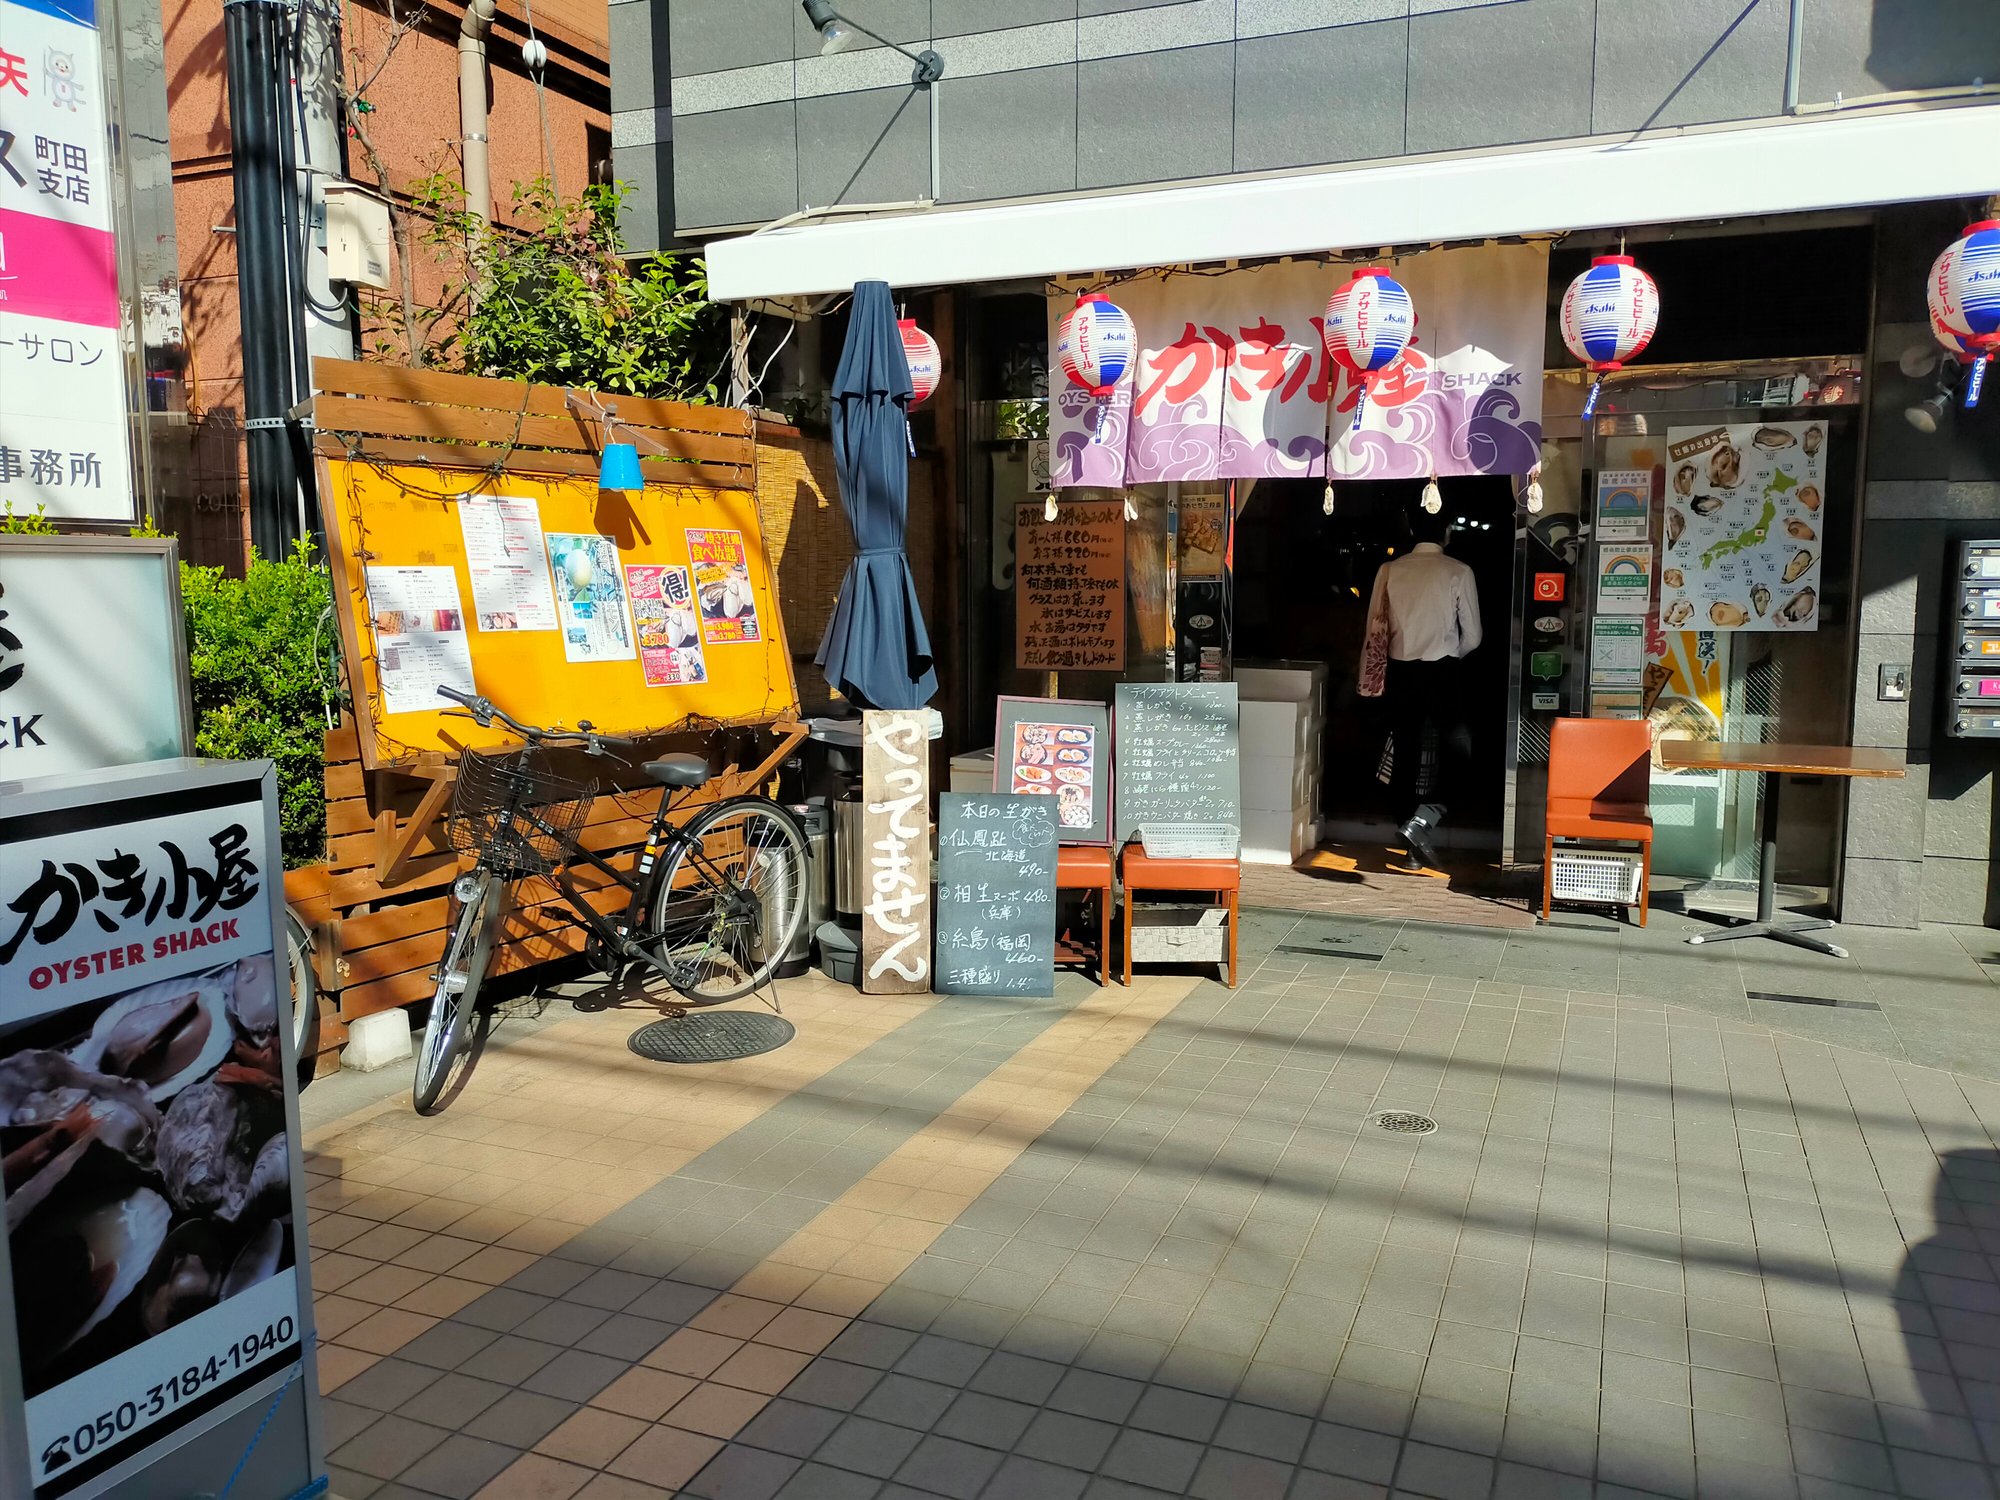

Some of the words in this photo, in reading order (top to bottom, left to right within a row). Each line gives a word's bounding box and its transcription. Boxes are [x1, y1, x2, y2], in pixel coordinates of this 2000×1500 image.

[35, 135, 89, 175] 町田
[37, 168, 91, 206] 支店
[1938, 251, 1956, 317] アサヒビール
[1357, 291, 1371, 349] アサヒビール
[1383, 313, 1407, 325] Asahi
[1565, 282, 1579, 343] アサヒビール
[1584, 302, 1616, 315] Asahi
[1626, 277, 1644, 339] アサヒビール
[1078, 315, 1094, 371] アサヒビール
[1103, 332, 1127, 342] Asahi
[1444, 373, 1522, 388] SHACK
[1968, 356, 1987, 403] アサヒビール
[661, 569, 689, 604] 得!
[1028, 620, 1042, 633] 水
[865, 713, 928, 983] やってません
[949, 828, 1007, 848] 仙鳳趾
[985, 849, 1030, 862] 北海道
[0, 824, 259, 966] かき小屋
[28, 942, 145, 990] OYSTER
[153, 917, 240, 959] SHACK
[947, 965, 1000, 986] 三種盛り
[73, 1314, 295, 1456] 050-3184-1940
